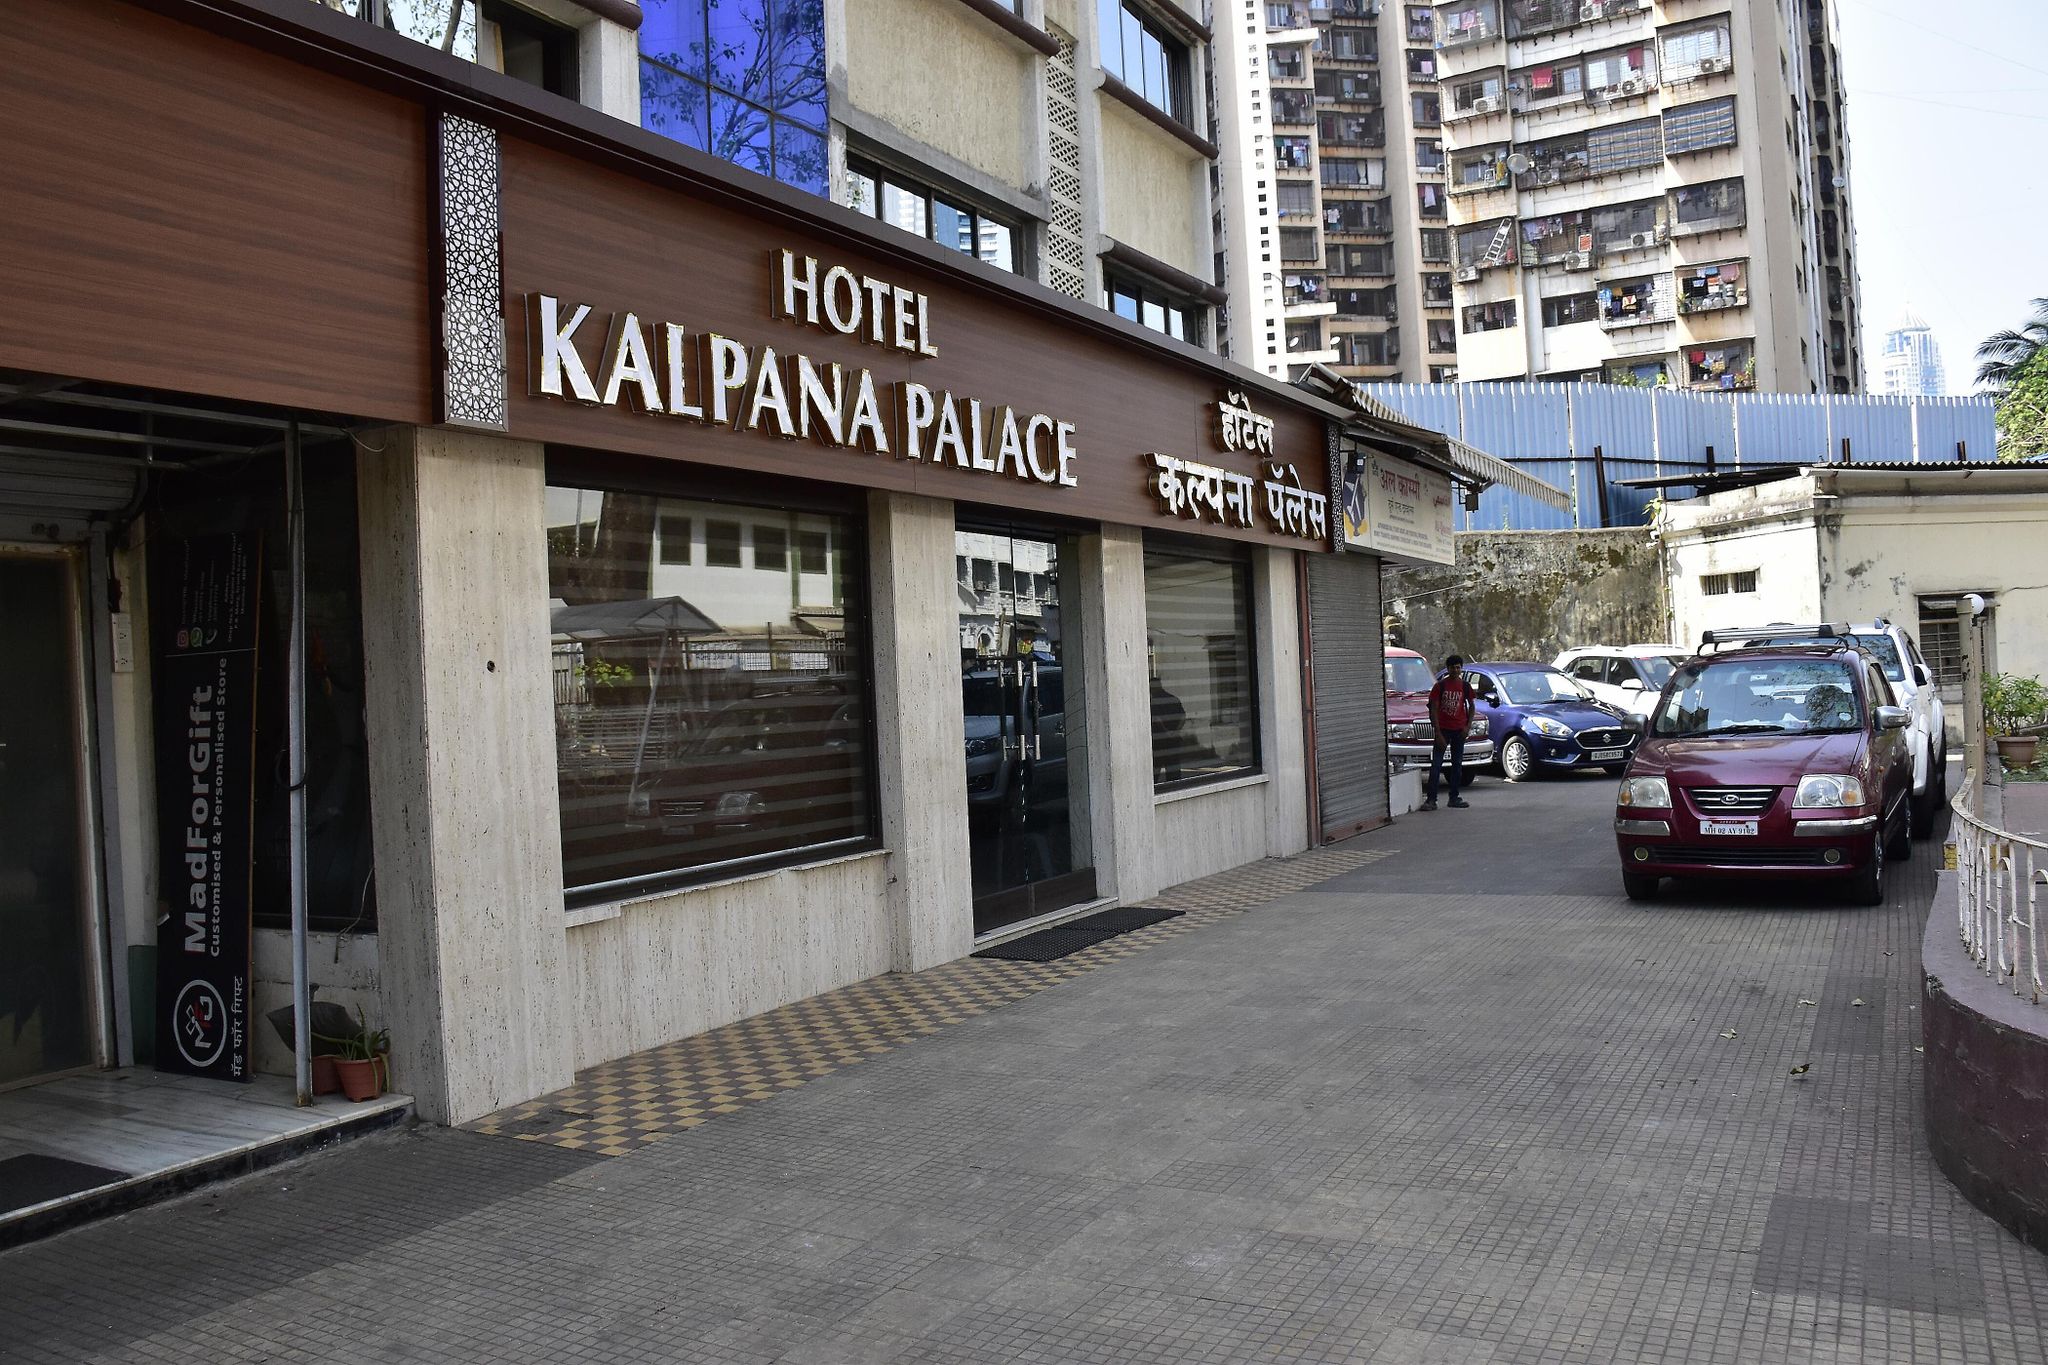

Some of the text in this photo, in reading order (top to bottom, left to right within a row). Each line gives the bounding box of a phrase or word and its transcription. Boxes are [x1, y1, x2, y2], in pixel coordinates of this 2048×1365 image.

[781, 247, 938, 358] HOTEL
[538, 293, 1078, 487] KALPANA PALACE
[1217, 389, 1274, 456] हॉटेल
[1153, 453, 1254, 528] कल्पना
[1441, 690, 1463, 700] RUN
[185, 685, 212, 953] MadForGift
[211, 658, 227, 957] Customised & Personalised Store
[231, 1018, 243, 1049] फॉर
